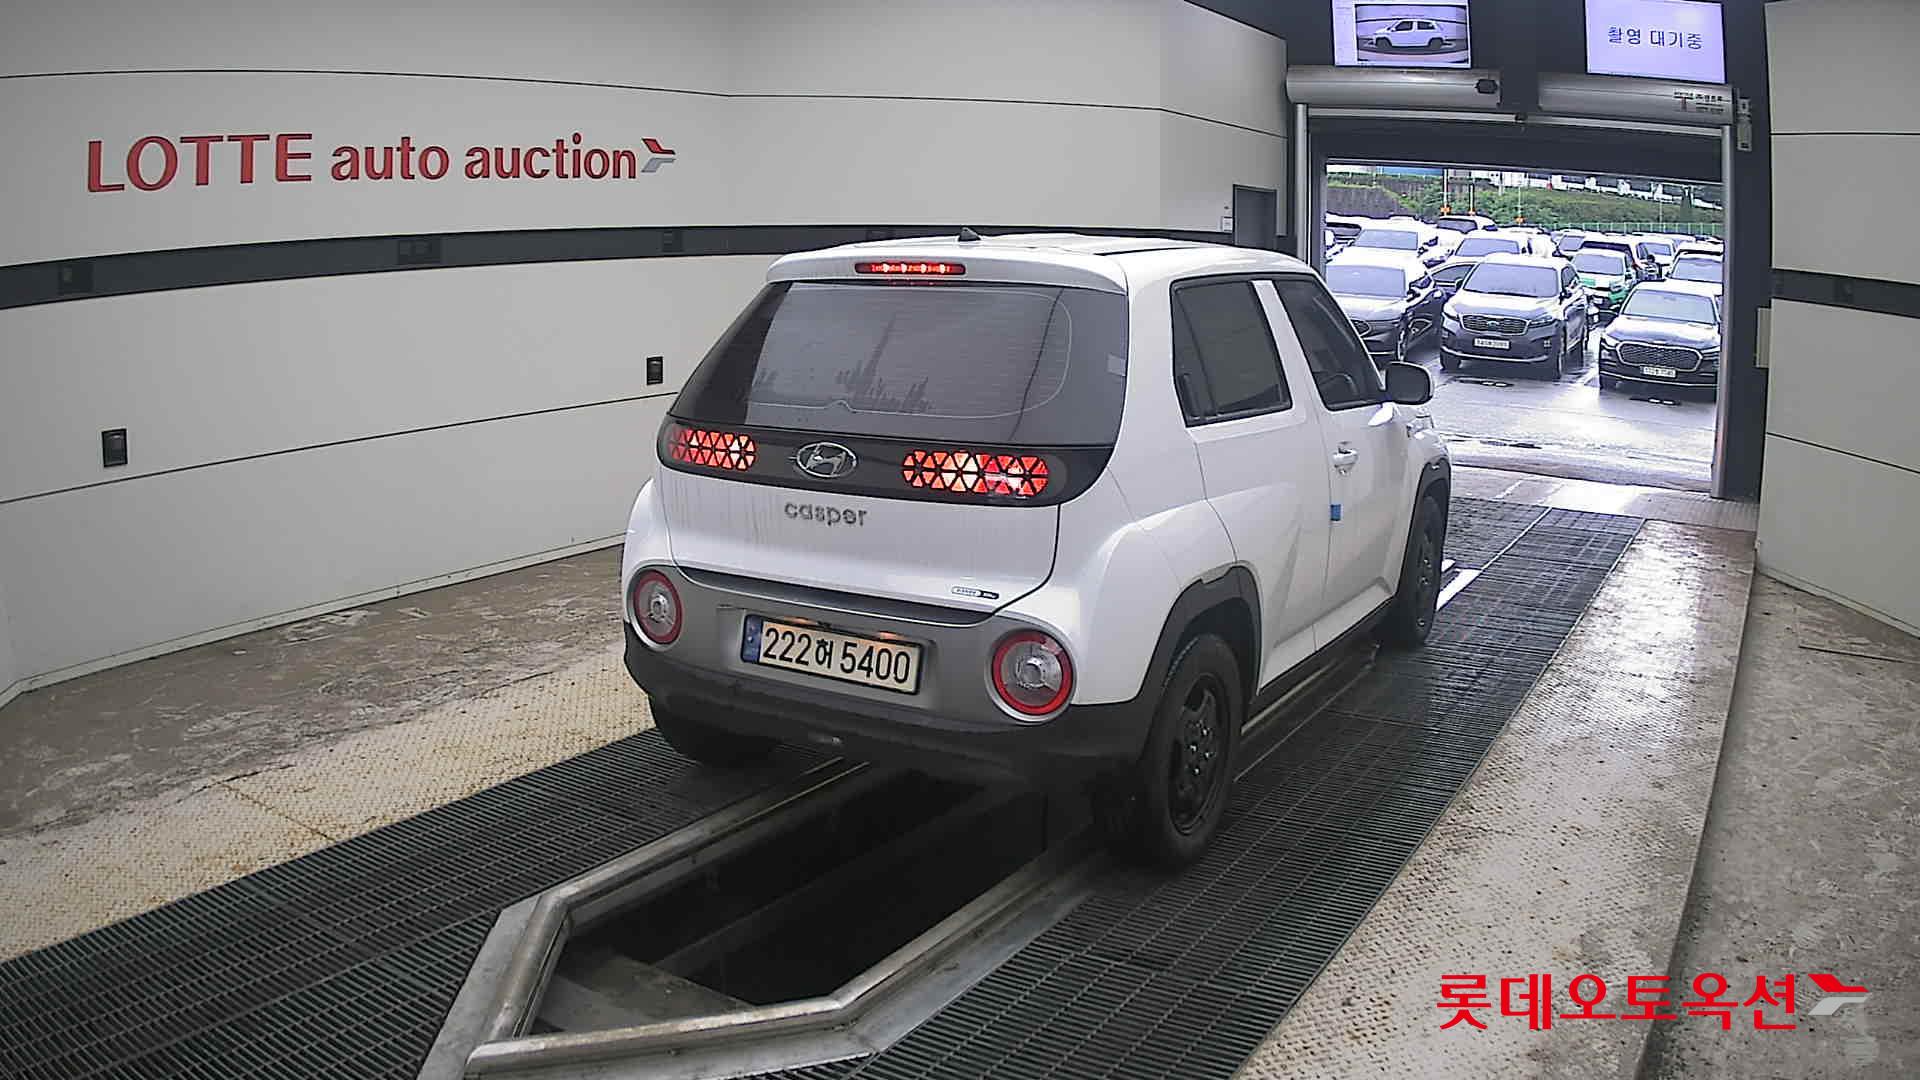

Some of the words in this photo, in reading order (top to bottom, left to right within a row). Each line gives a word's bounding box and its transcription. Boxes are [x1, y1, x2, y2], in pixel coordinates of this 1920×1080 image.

[1607, 26, 1641, 45] 촬영
[1650, 29, 1703, 50] 대기중
[87, 133, 313, 193] LOTTE
[331, 136, 450, 182] auto
[464, 132, 638, 181] auction
[784, 503, 868, 527] casper
[762, 627, 834, 669] 222허
[840, 640, 911, 684] 5400
